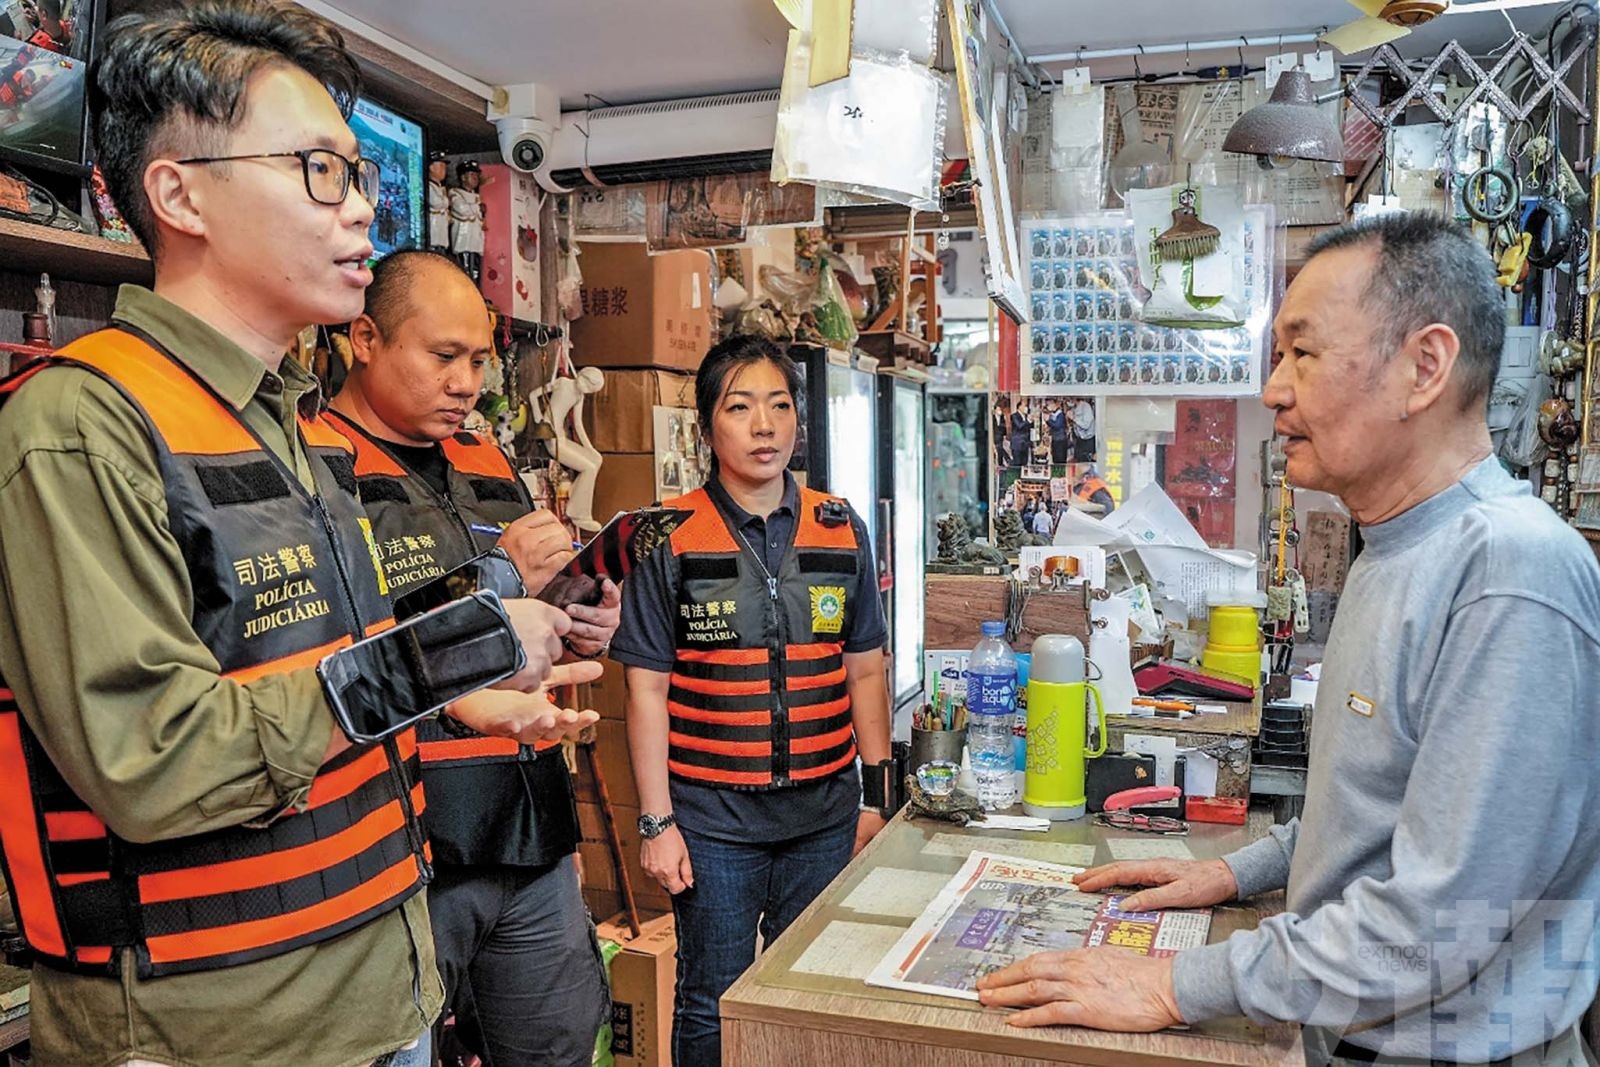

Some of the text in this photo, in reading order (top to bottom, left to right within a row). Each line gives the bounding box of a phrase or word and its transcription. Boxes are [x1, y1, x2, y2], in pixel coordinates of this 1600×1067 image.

[233, 544, 317, 585] 司法警察
[384, 553, 434, 573] POLÍCIA
[387, 565, 446, 589] UDICIÁRIA
[255, 579, 317, 610] POLÍCIA
[243, 600, 330, 638] JUDICIÁRIA
[680, 600, 737, 618] 司法警察
[689, 618, 728, 631] POLÍCIA
